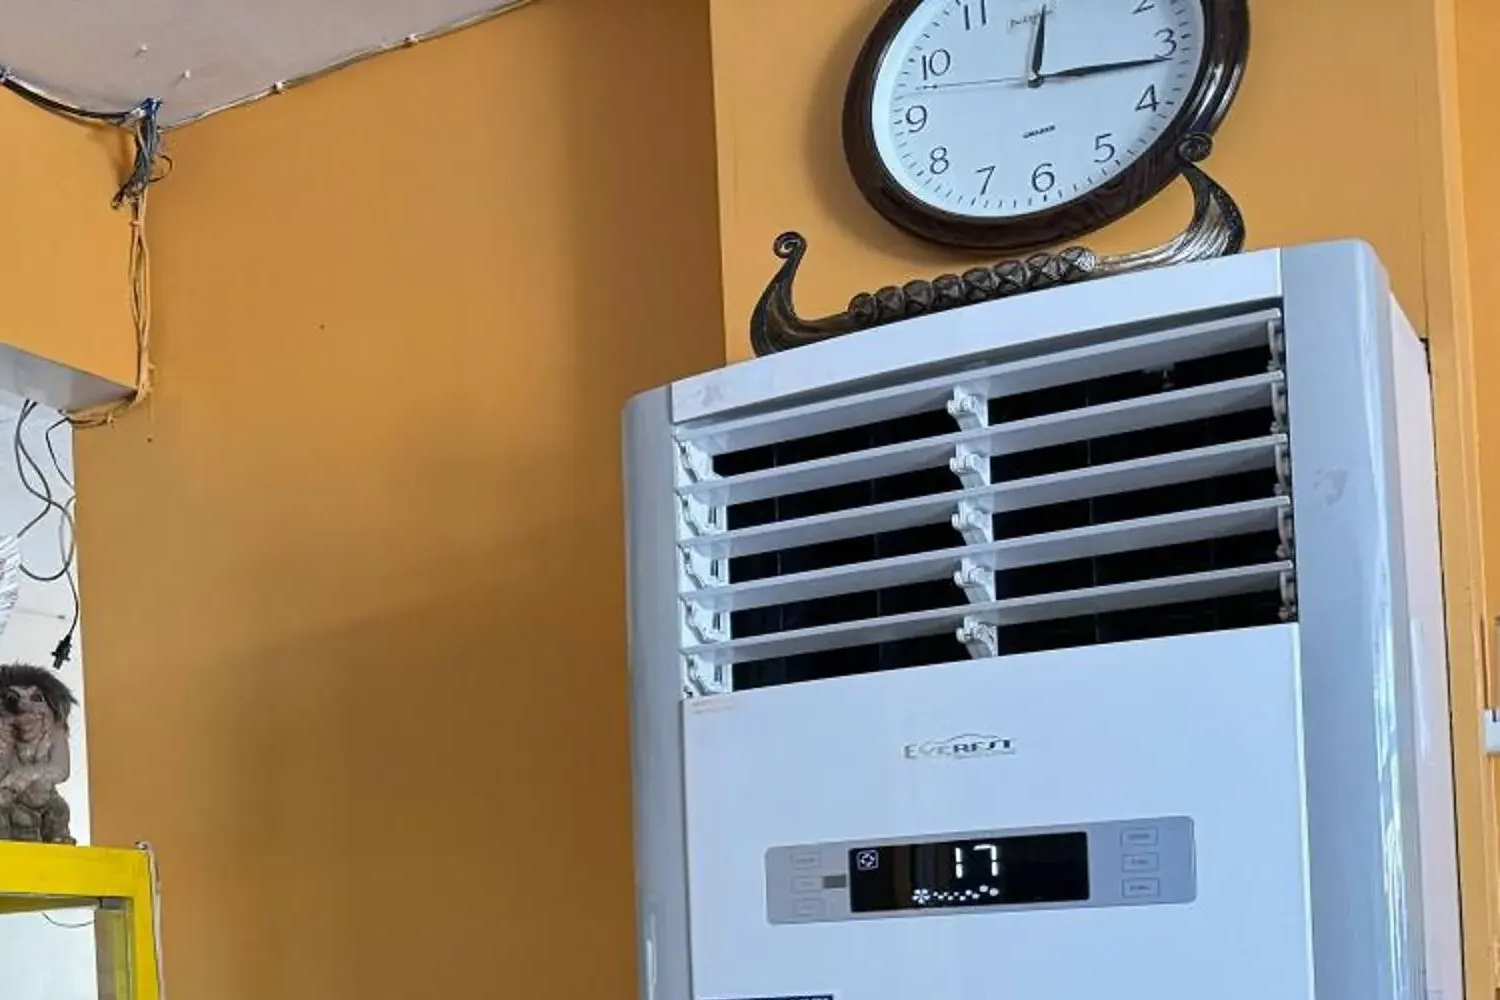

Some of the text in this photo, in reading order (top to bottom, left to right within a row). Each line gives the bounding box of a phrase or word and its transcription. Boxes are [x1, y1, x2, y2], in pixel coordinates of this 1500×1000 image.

[963, 0, 987, 31] 11
[1153, 27, 1178, 58] 3
[921, 48, 951, 81] 10
[1135, 84, 1159, 112] 4
[905, 104, 928, 133] 9
[928, 146, 950, 175] 8
[1093, 133, 1116, 163] 5
[974, 165, 997, 196] 7
[1031, 162, 1055, 193] 6
[955, 843, 999, 879] 17
